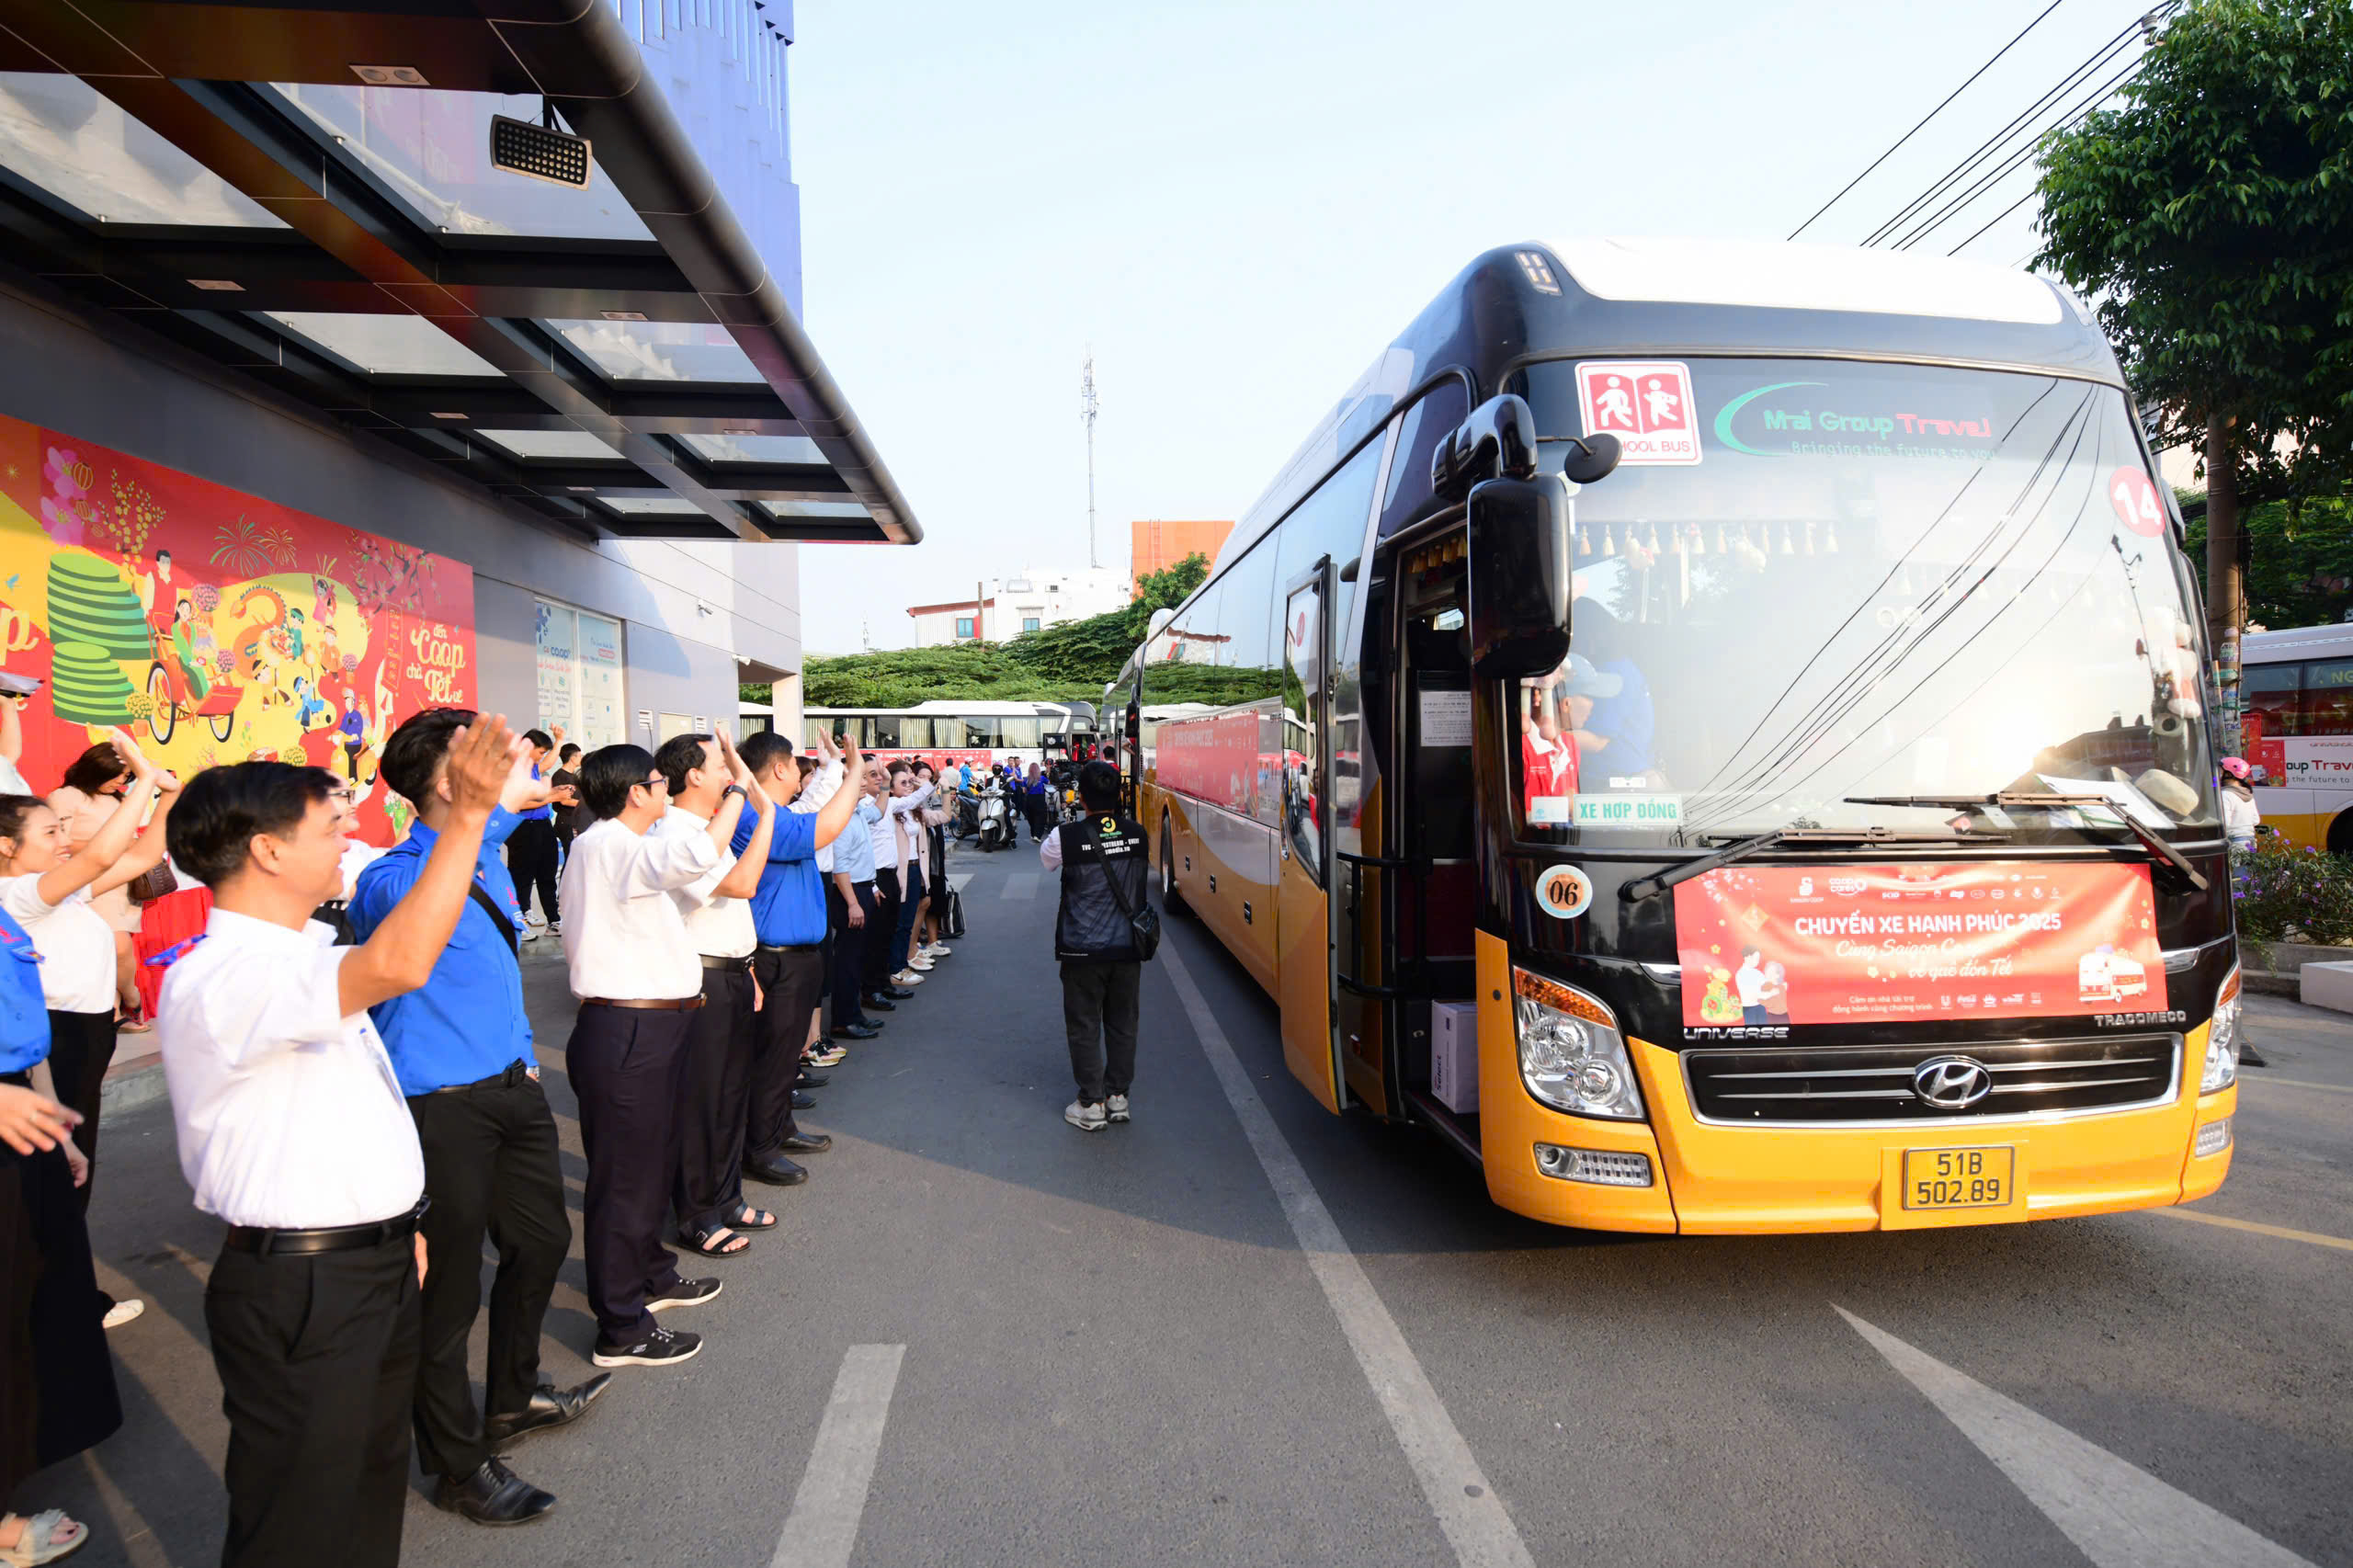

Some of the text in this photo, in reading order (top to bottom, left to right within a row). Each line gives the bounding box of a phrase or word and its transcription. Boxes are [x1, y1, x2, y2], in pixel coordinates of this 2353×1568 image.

[1764, 409, 1992, 440] Mai Group Travel
[1661, 440, 1691, 452] BUS
[1792, 441, 1861, 457] Bringing
[1867, 442, 1892, 456] the
[1896, 443, 1945, 458] future
[2114, 482, 2162, 526] 14
[410, 629, 466, 678] Coop
[424, 669, 453, 703] Tết
[2287, 760, 2353, 774] oup Trav
[1580, 803, 1597, 819] XE
[1603, 801, 1632, 822] HỢP
[1102, 839, 1124, 848] ESTREAM
[1550, 881, 1578, 906] 06
[1794, 909, 2062, 937] CHUYẾN XE HẠNH PHÚC 2025
[1835, 938, 1877, 961] Cùng
[1880, 937, 1937, 961] Saigon
[2094, 1010, 2187, 1027] TRACOMECO
[1683, 1027, 1790, 1040] UNIVERSE
[1937, 1152, 1983, 1176] 51B
[1917, 1178, 2000, 1205] 502.89
